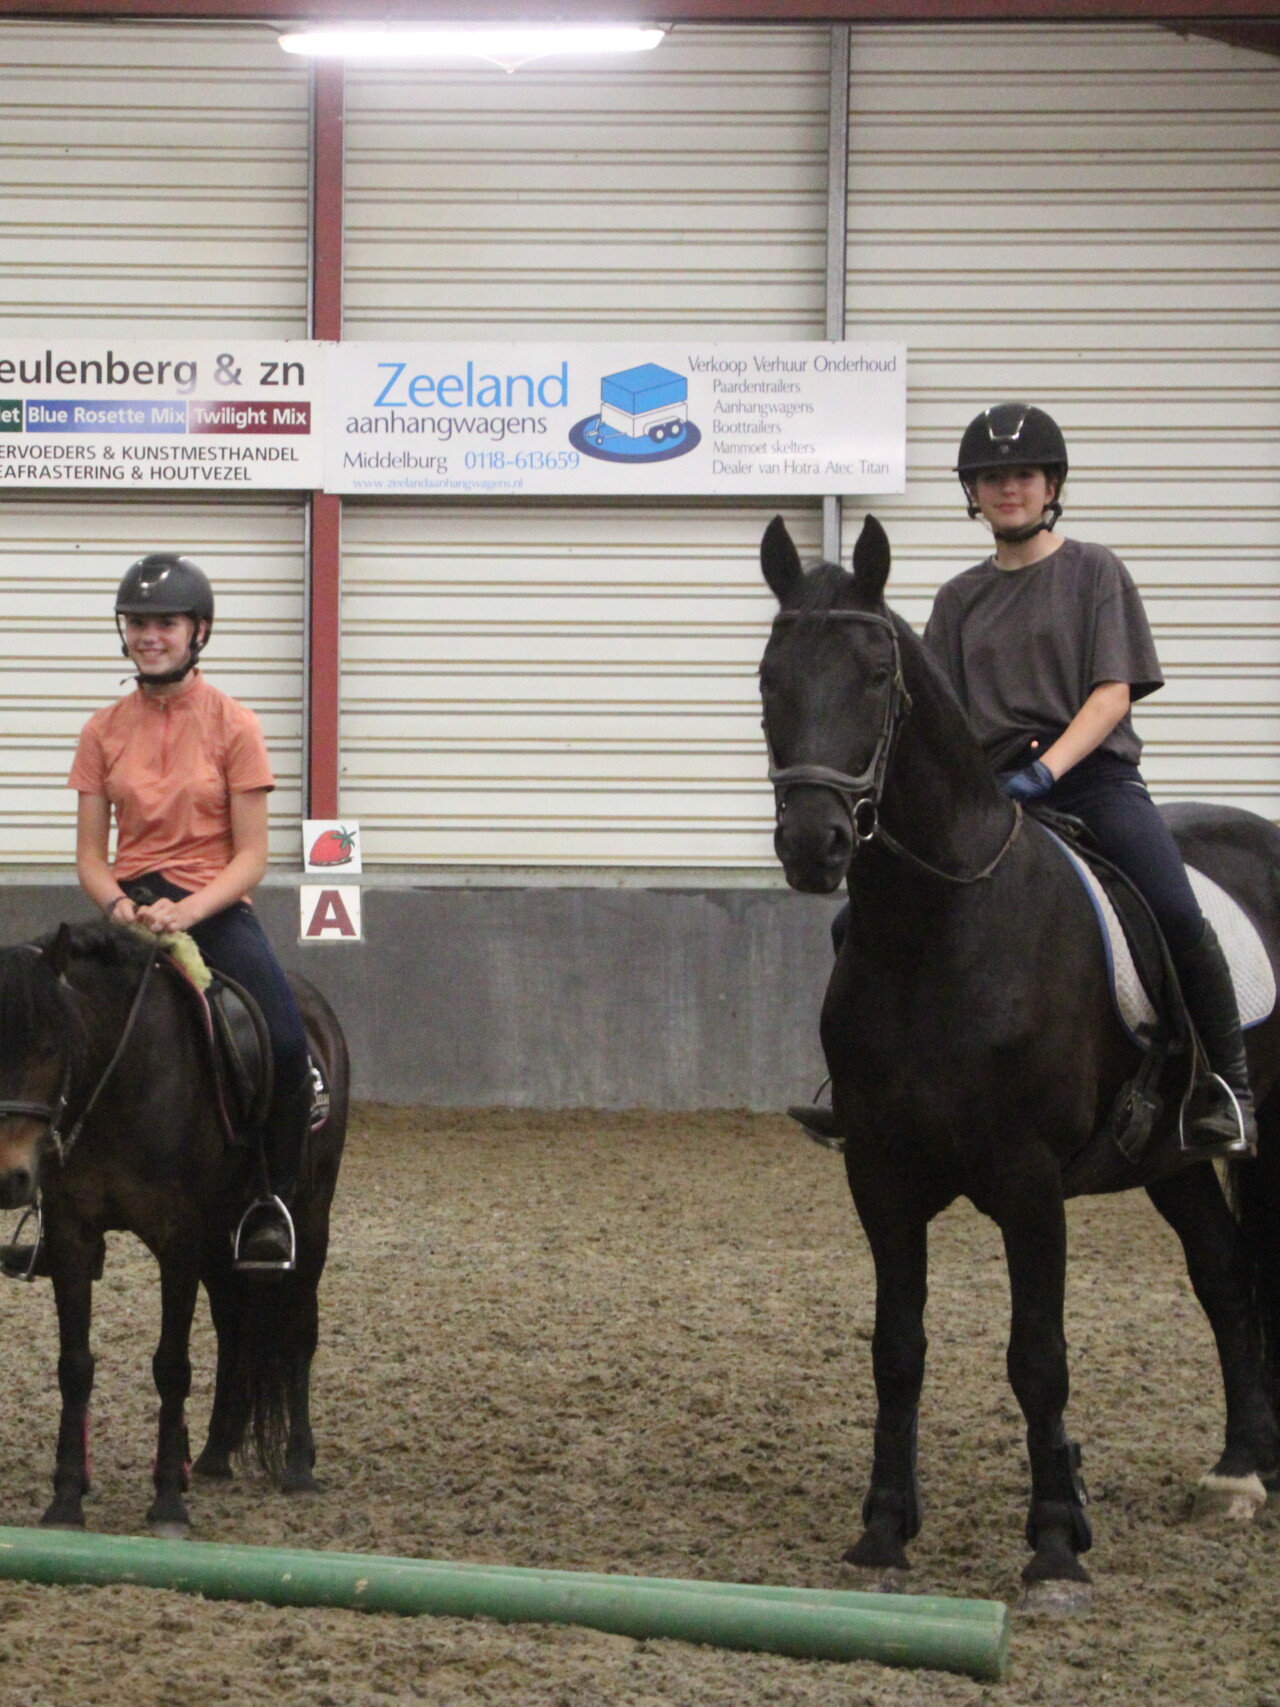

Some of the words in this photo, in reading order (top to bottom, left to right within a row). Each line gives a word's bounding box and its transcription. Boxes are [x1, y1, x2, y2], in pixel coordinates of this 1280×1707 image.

[214, 353, 242, 386] &
[259, 361, 305, 386] zn
[688, 356, 747, 376] Verkoop
[753, 356, 807, 372] Verhuur
[814, 355, 897, 373] Onderhoud
[373, 361, 568, 408] Zeeland
[713, 379, 801, 393] Paardentrailers
[28, 406, 68, 423] Blue
[74, 407, 145, 424] Rosette
[151, 407, 186, 424] Mix
[194, 408, 267, 428] Twilight
[273, 408, 307, 425] Mix
[713, 400, 815, 418] Aanhangwagens
[346, 410, 547, 441] aanhangwagens
[712, 419, 782, 434] Boottrailers
[103, 446, 116, 460] &
[122, 446, 299, 462] KUNSTMESTHANDEL
[713, 440, 768, 454] Mammoet
[771, 440, 816, 454] skelters
[343, 451, 448, 474] Middelburg
[464, 451, 580, 470] 0118-613659
[712, 460, 754, 475] Dealer
[758, 463, 780, 475] van
[784, 460, 820, 475] Hotra
[825, 460, 853, 475] Atec
[859, 459, 890, 475] Titan
[131, 466, 144, 480] &
[150, 466, 252, 481] HOUTVEZEL
[306, 889, 357, 937] A
